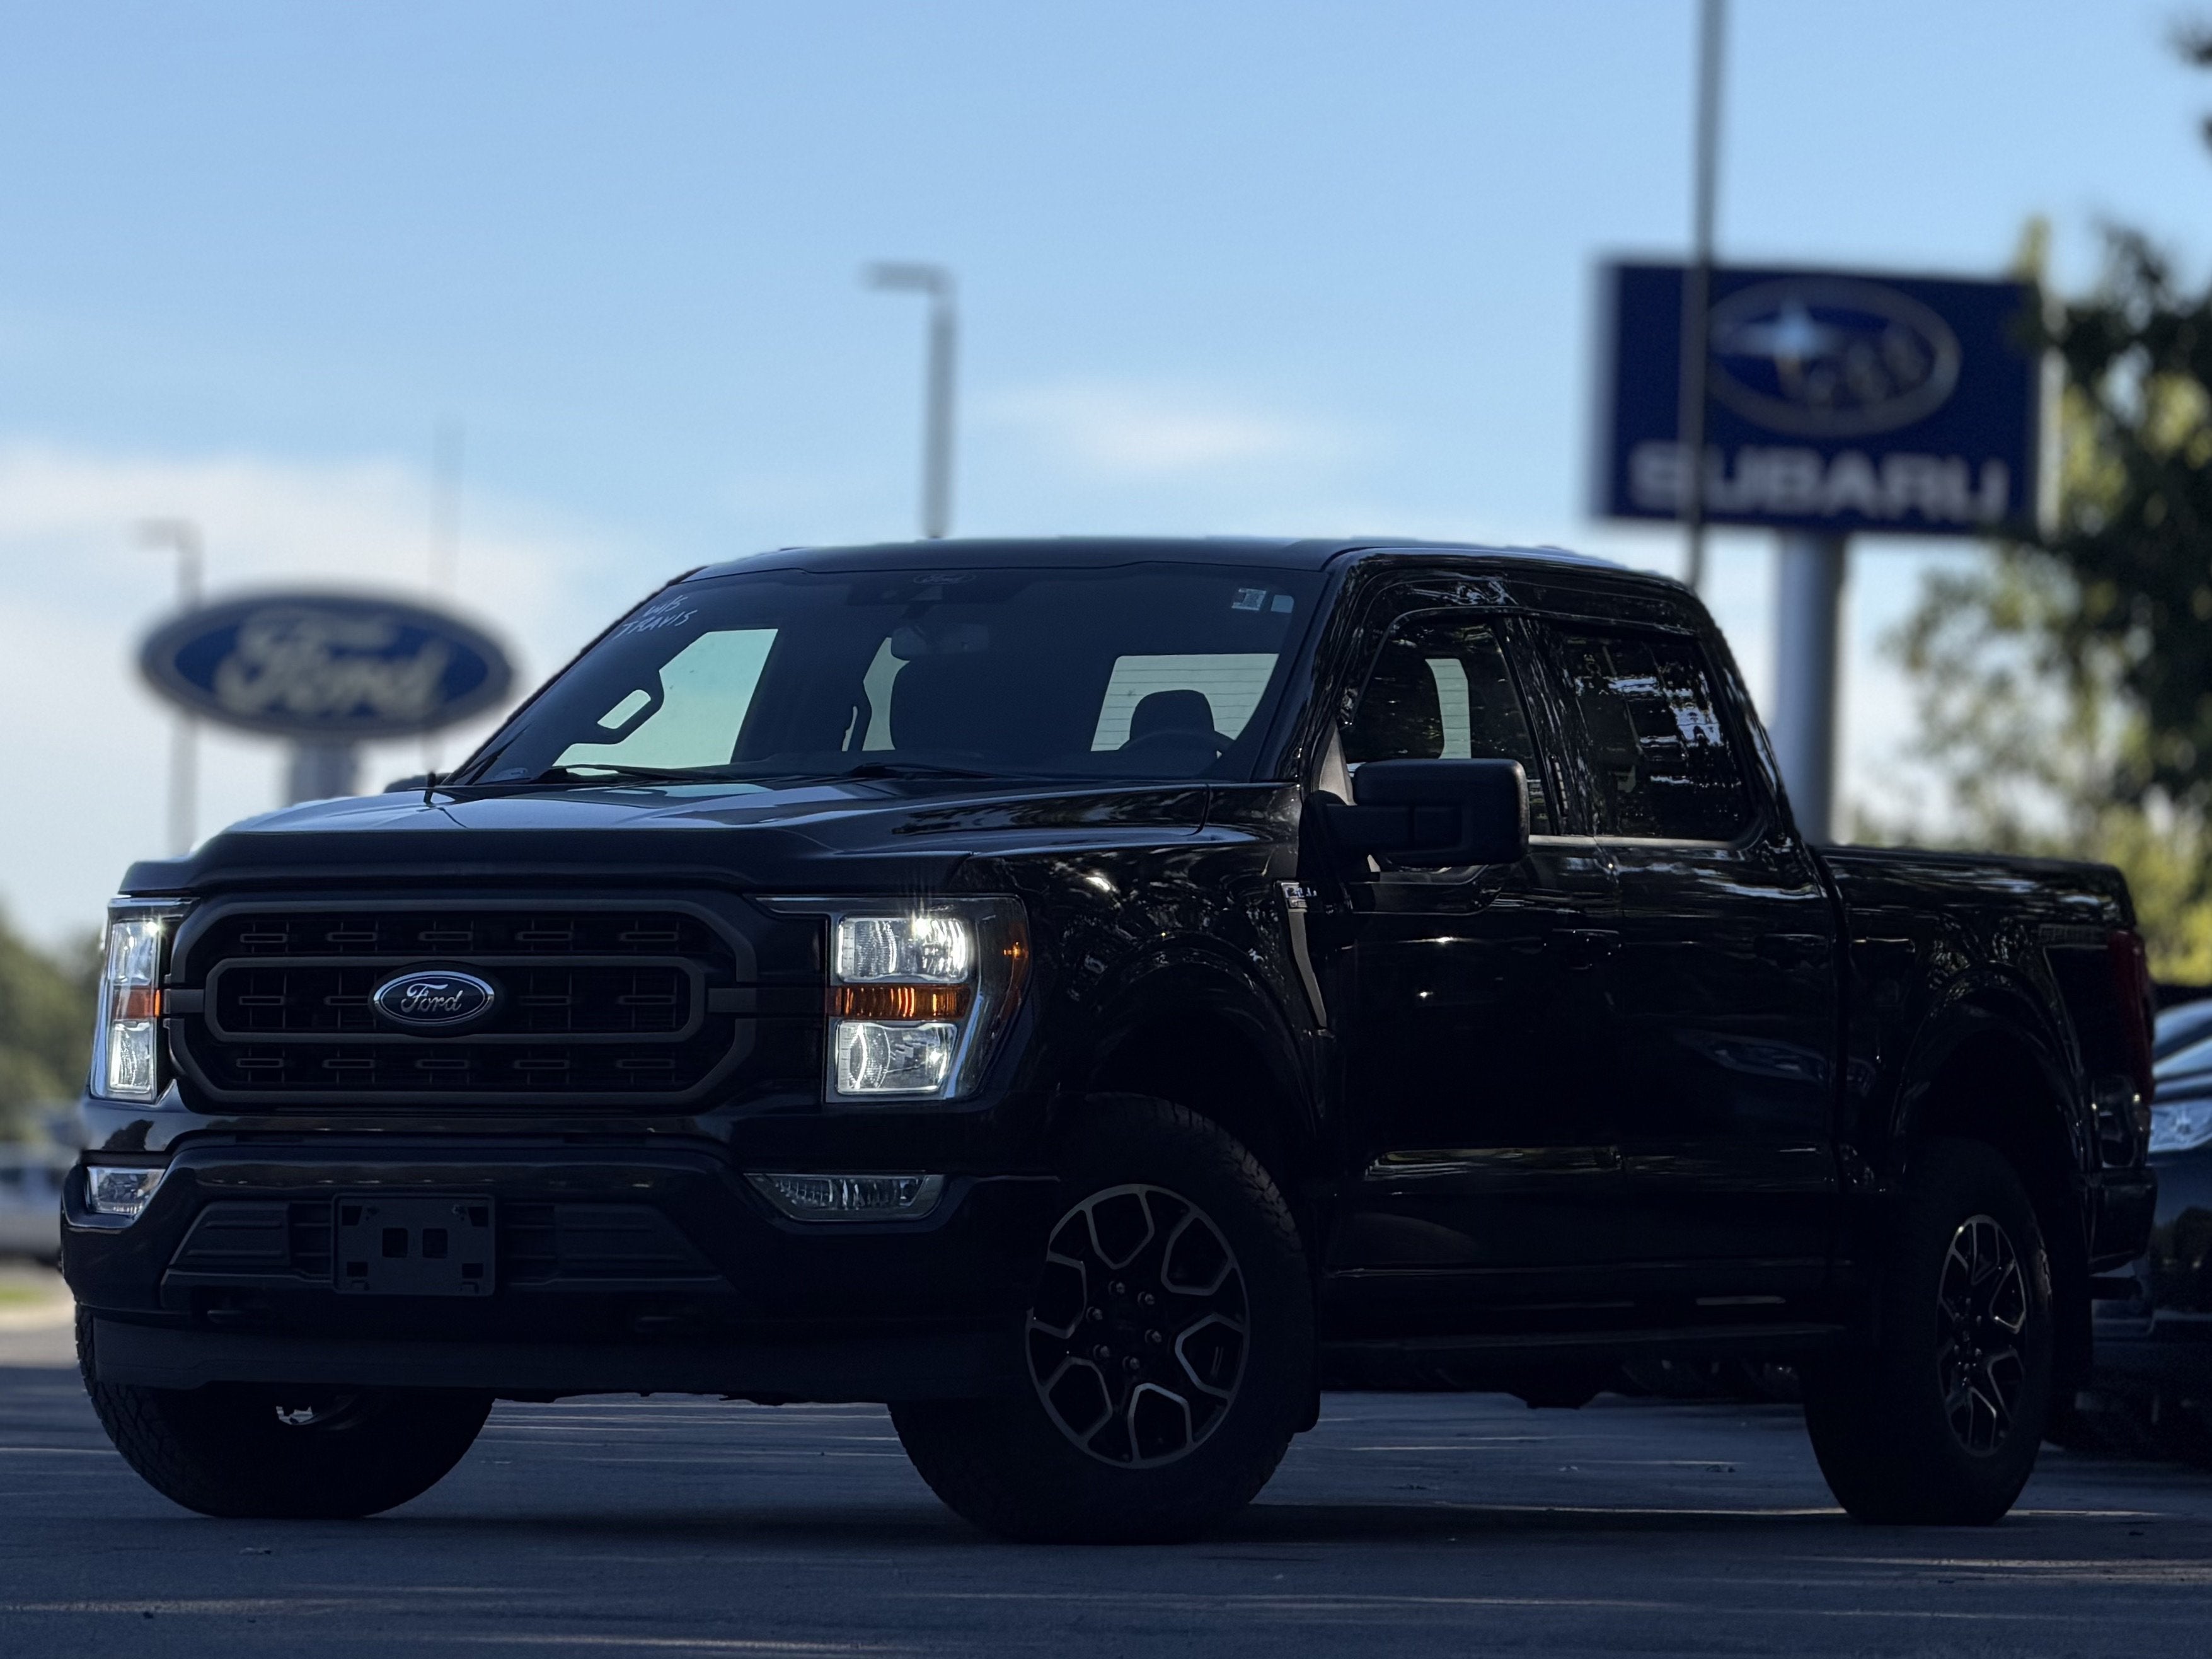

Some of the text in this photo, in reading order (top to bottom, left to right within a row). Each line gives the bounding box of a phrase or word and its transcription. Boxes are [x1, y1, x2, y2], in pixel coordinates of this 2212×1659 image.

[1629, 441, 2010, 522] SUBARU
[611, 610, 698, 641] TRAVIS
[213, 609, 446, 720] Ford
[400, 983, 464, 1014] Ford
